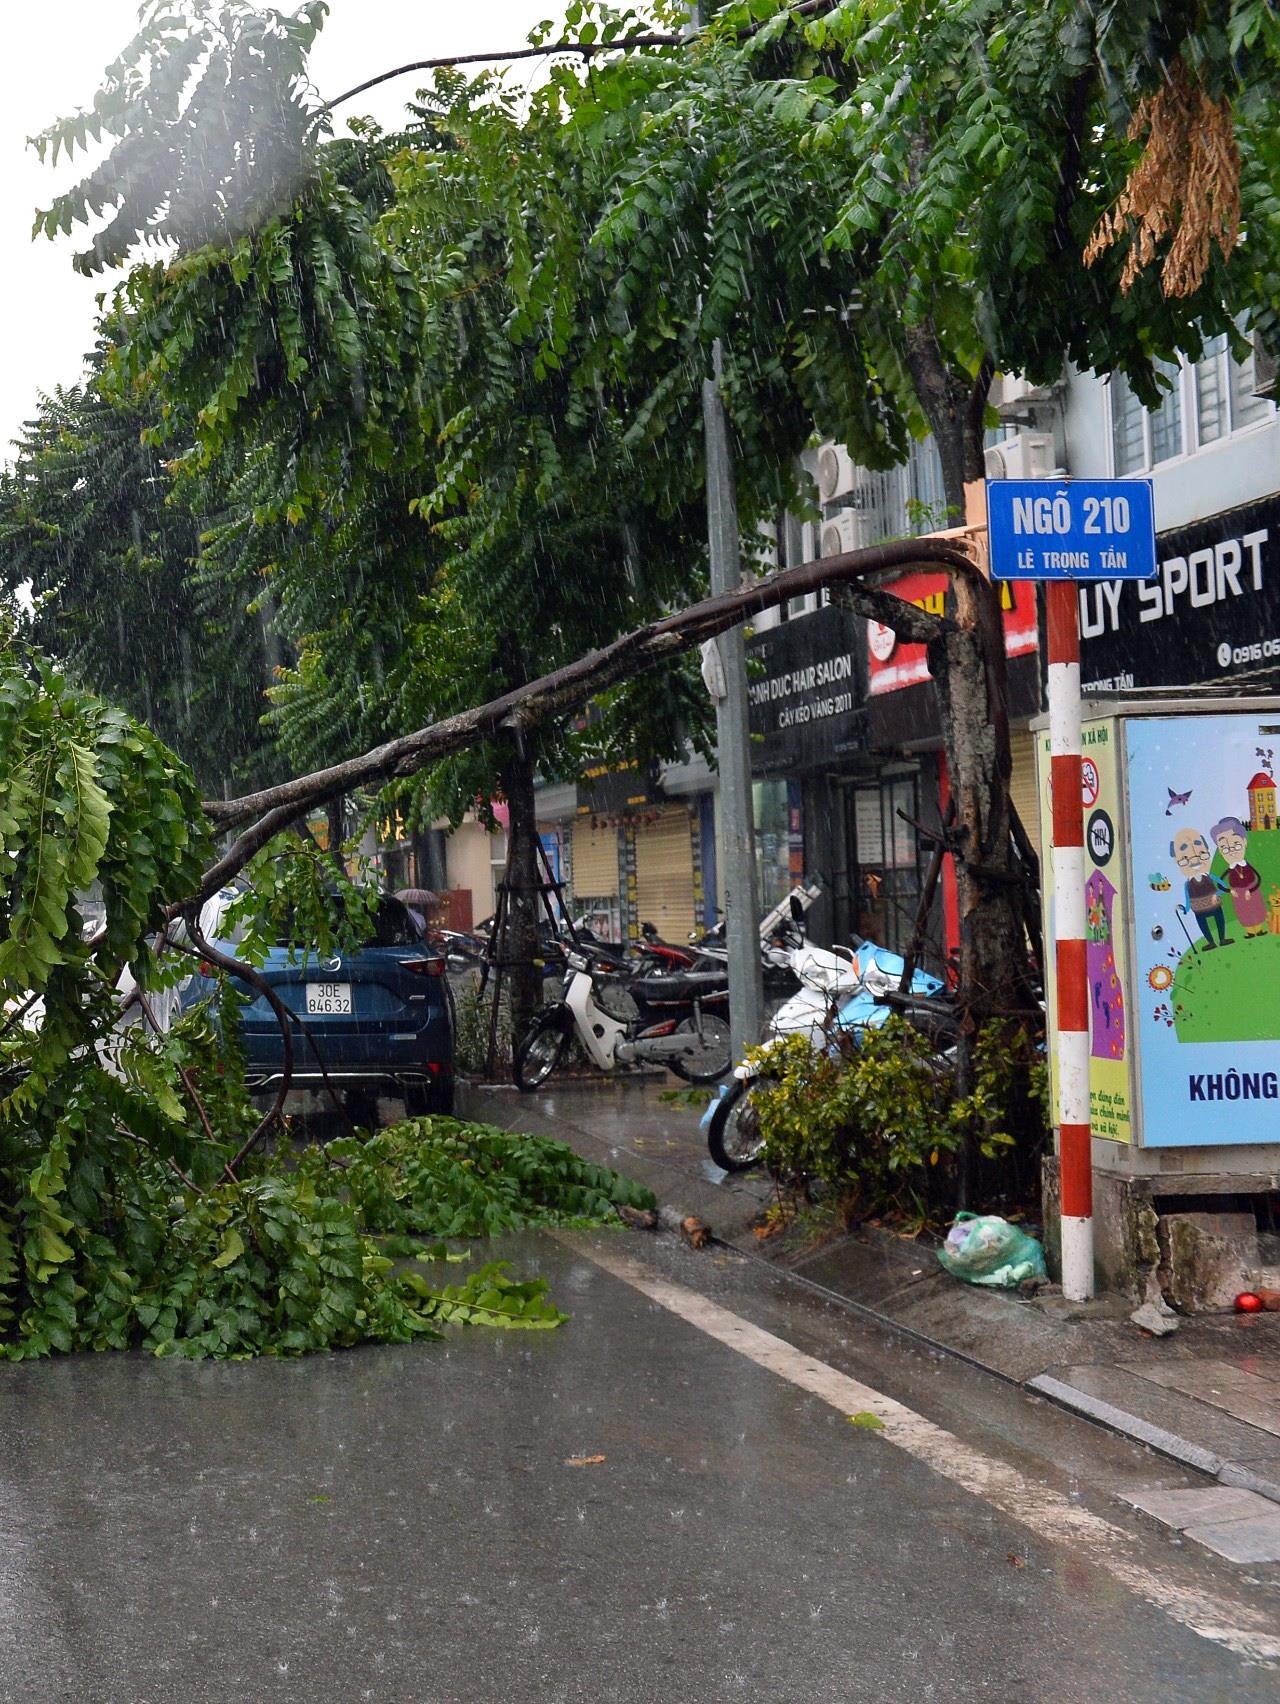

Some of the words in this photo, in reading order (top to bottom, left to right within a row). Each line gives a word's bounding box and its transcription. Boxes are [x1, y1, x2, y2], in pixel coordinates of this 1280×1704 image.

[1012, 490, 1071, 535] NGÕ
[1083, 497, 1131, 535] 210
[1018, 548, 1034, 569] LÊ
[1042, 552, 1090, 573] TRỌNG
[1099, 545, 1128, 569] TẤN
[1078, 579, 1123, 639] UY
[1137, 529, 1269, 623] SPORT
[770, 674, 791, 699] DUC
[792, 666, 816, 693] HAIR
[816, 654, 852, 686] SALON
[810, 696, 834, 719] VÀNG
[834, 693, 852, 713] 2011
[309, 999, 350, 1012] 846.32
[318, 984, 340, 998] 30E
[1189, 1068, 1278, 1101] KHÔNG
